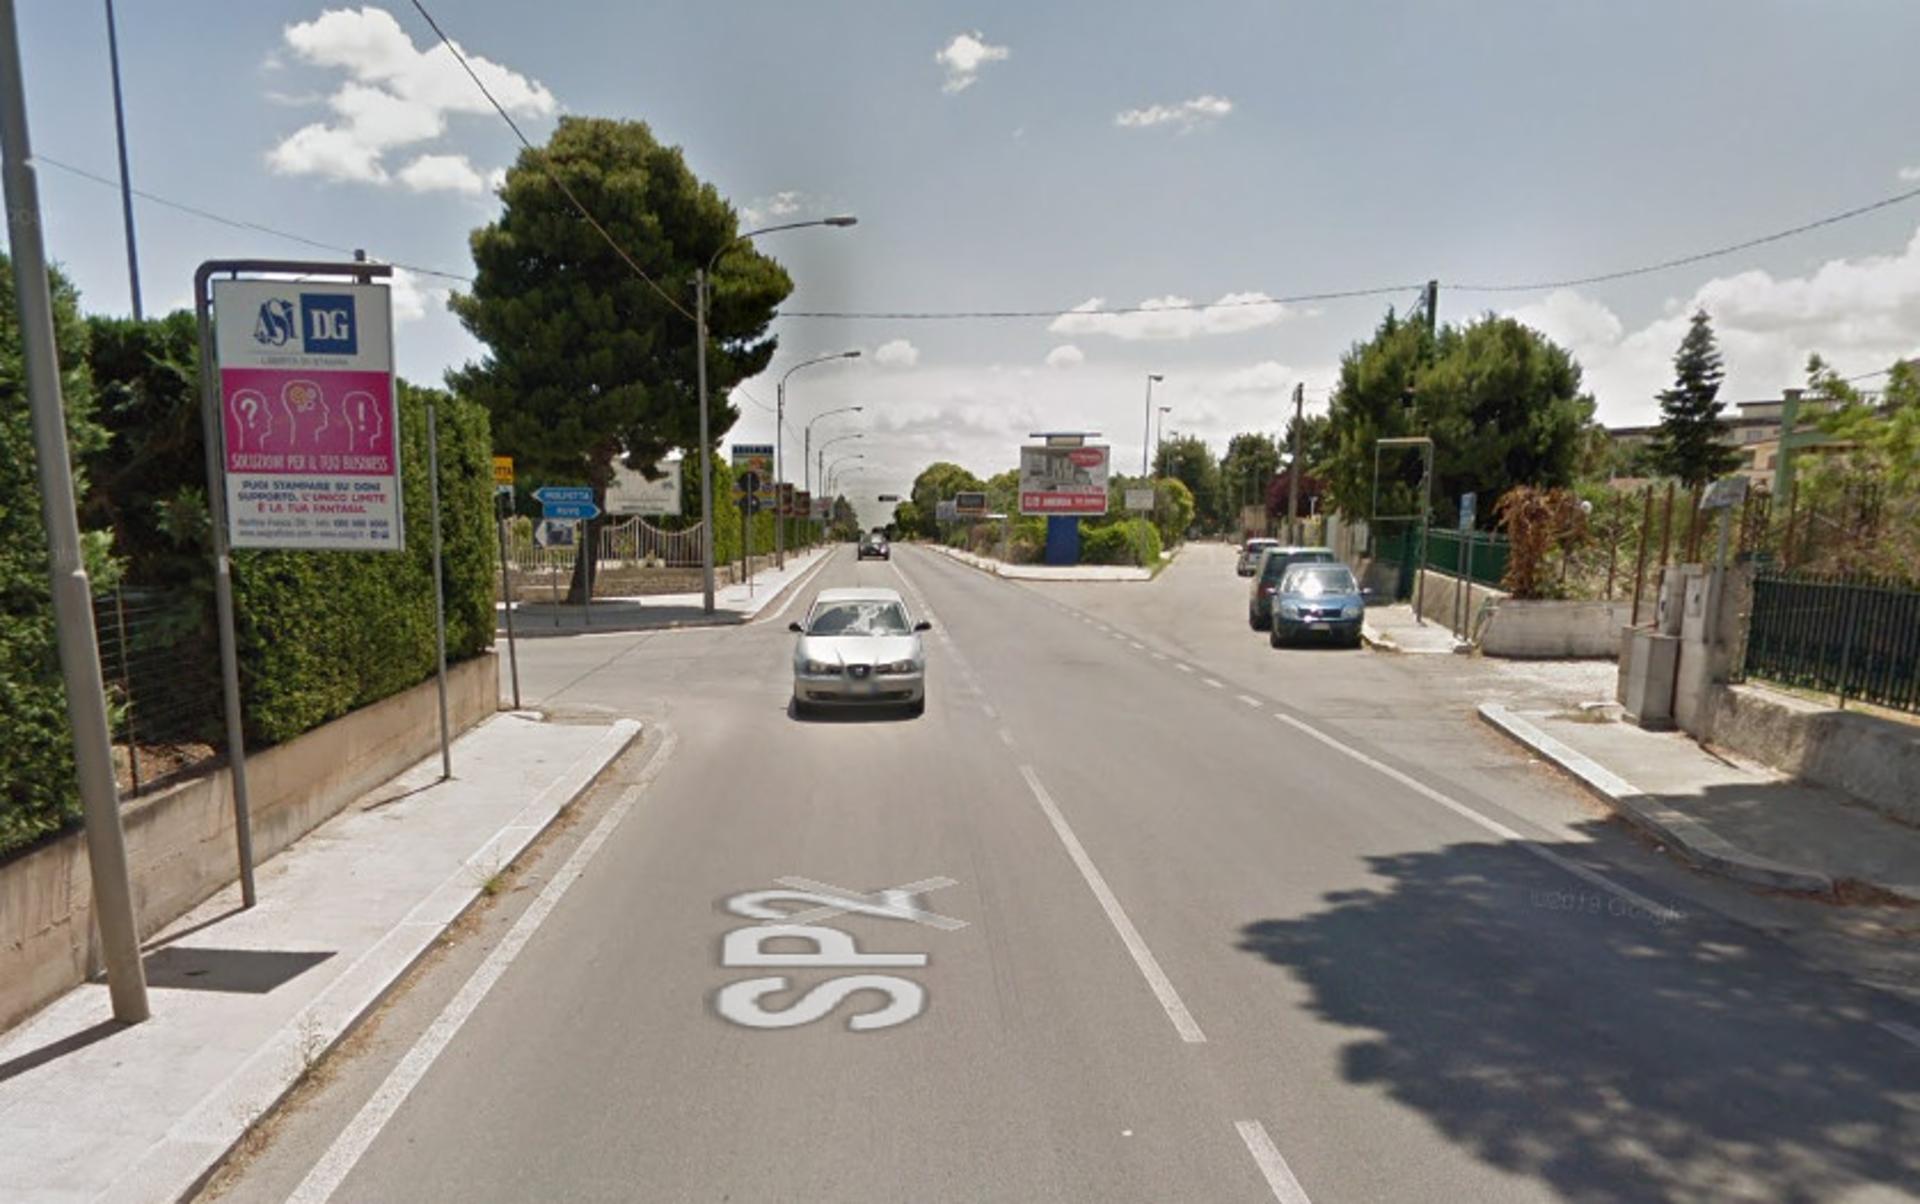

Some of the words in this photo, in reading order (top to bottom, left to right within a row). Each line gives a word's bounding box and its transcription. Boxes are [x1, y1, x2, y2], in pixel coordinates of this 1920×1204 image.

[310, 310, 349, 340] DG
[232, 453, 284, 469] SOLUZIONI
[287, 455, 305, 469] PER
[308, 456, 317, 470] IL
[320, 456, 339, 470] TUO
[342, 456, 388, 471] BUSINESS
[242, 481, 268, 490] PUOI
[273, 481, 330, 491] STAMPARE
[336, 482, 349, 491] SU
[302, 493, 348, 502] L'UNICO
[352, 494, 387, 503] LIMITE
[544, 492, 590, 500] MOLFETTA
[269, 504, 283, 513] LA
[288, 504, 309, 513] TUA
